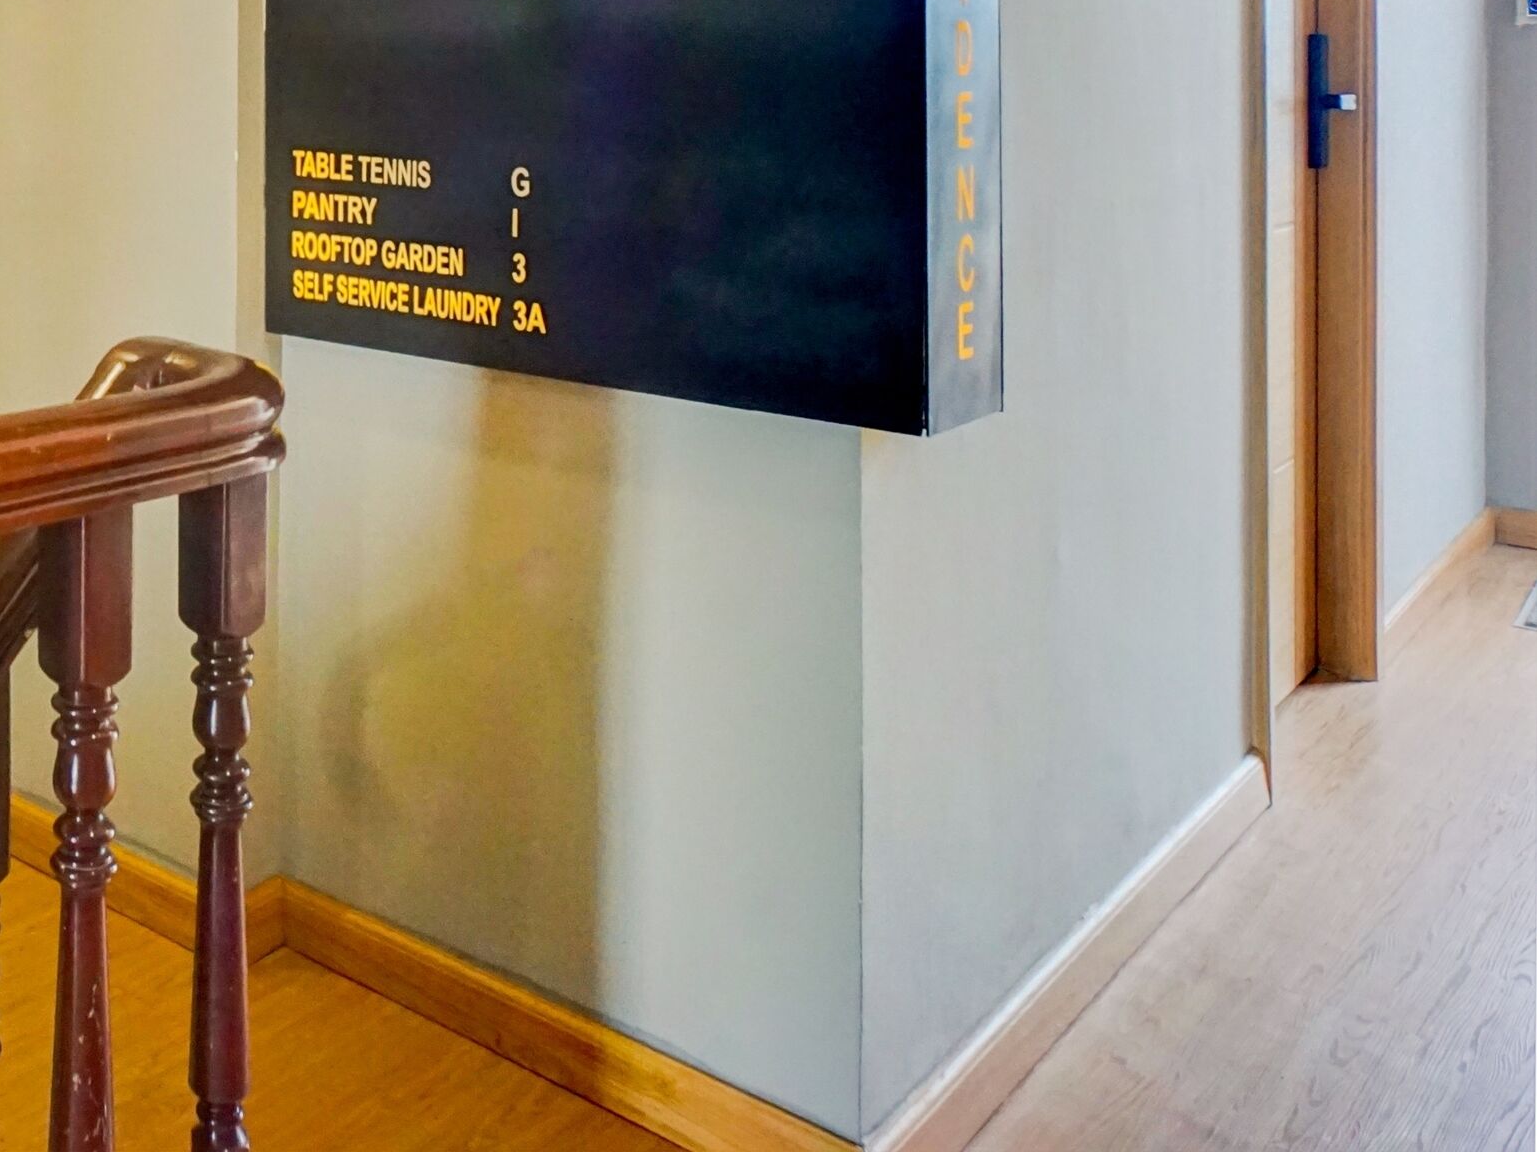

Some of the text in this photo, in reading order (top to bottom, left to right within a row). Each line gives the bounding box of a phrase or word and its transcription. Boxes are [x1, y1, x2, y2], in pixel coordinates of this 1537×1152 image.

[292, 149, 531, 198] TABLE TENNIS G
[292, 190, 377, 225] PANTRY
[291, 230, 527, 284] ROOFTOP GARDEN 3
[292, 269, 547, 334] SELF SERVICE LAUNDRY 3A
